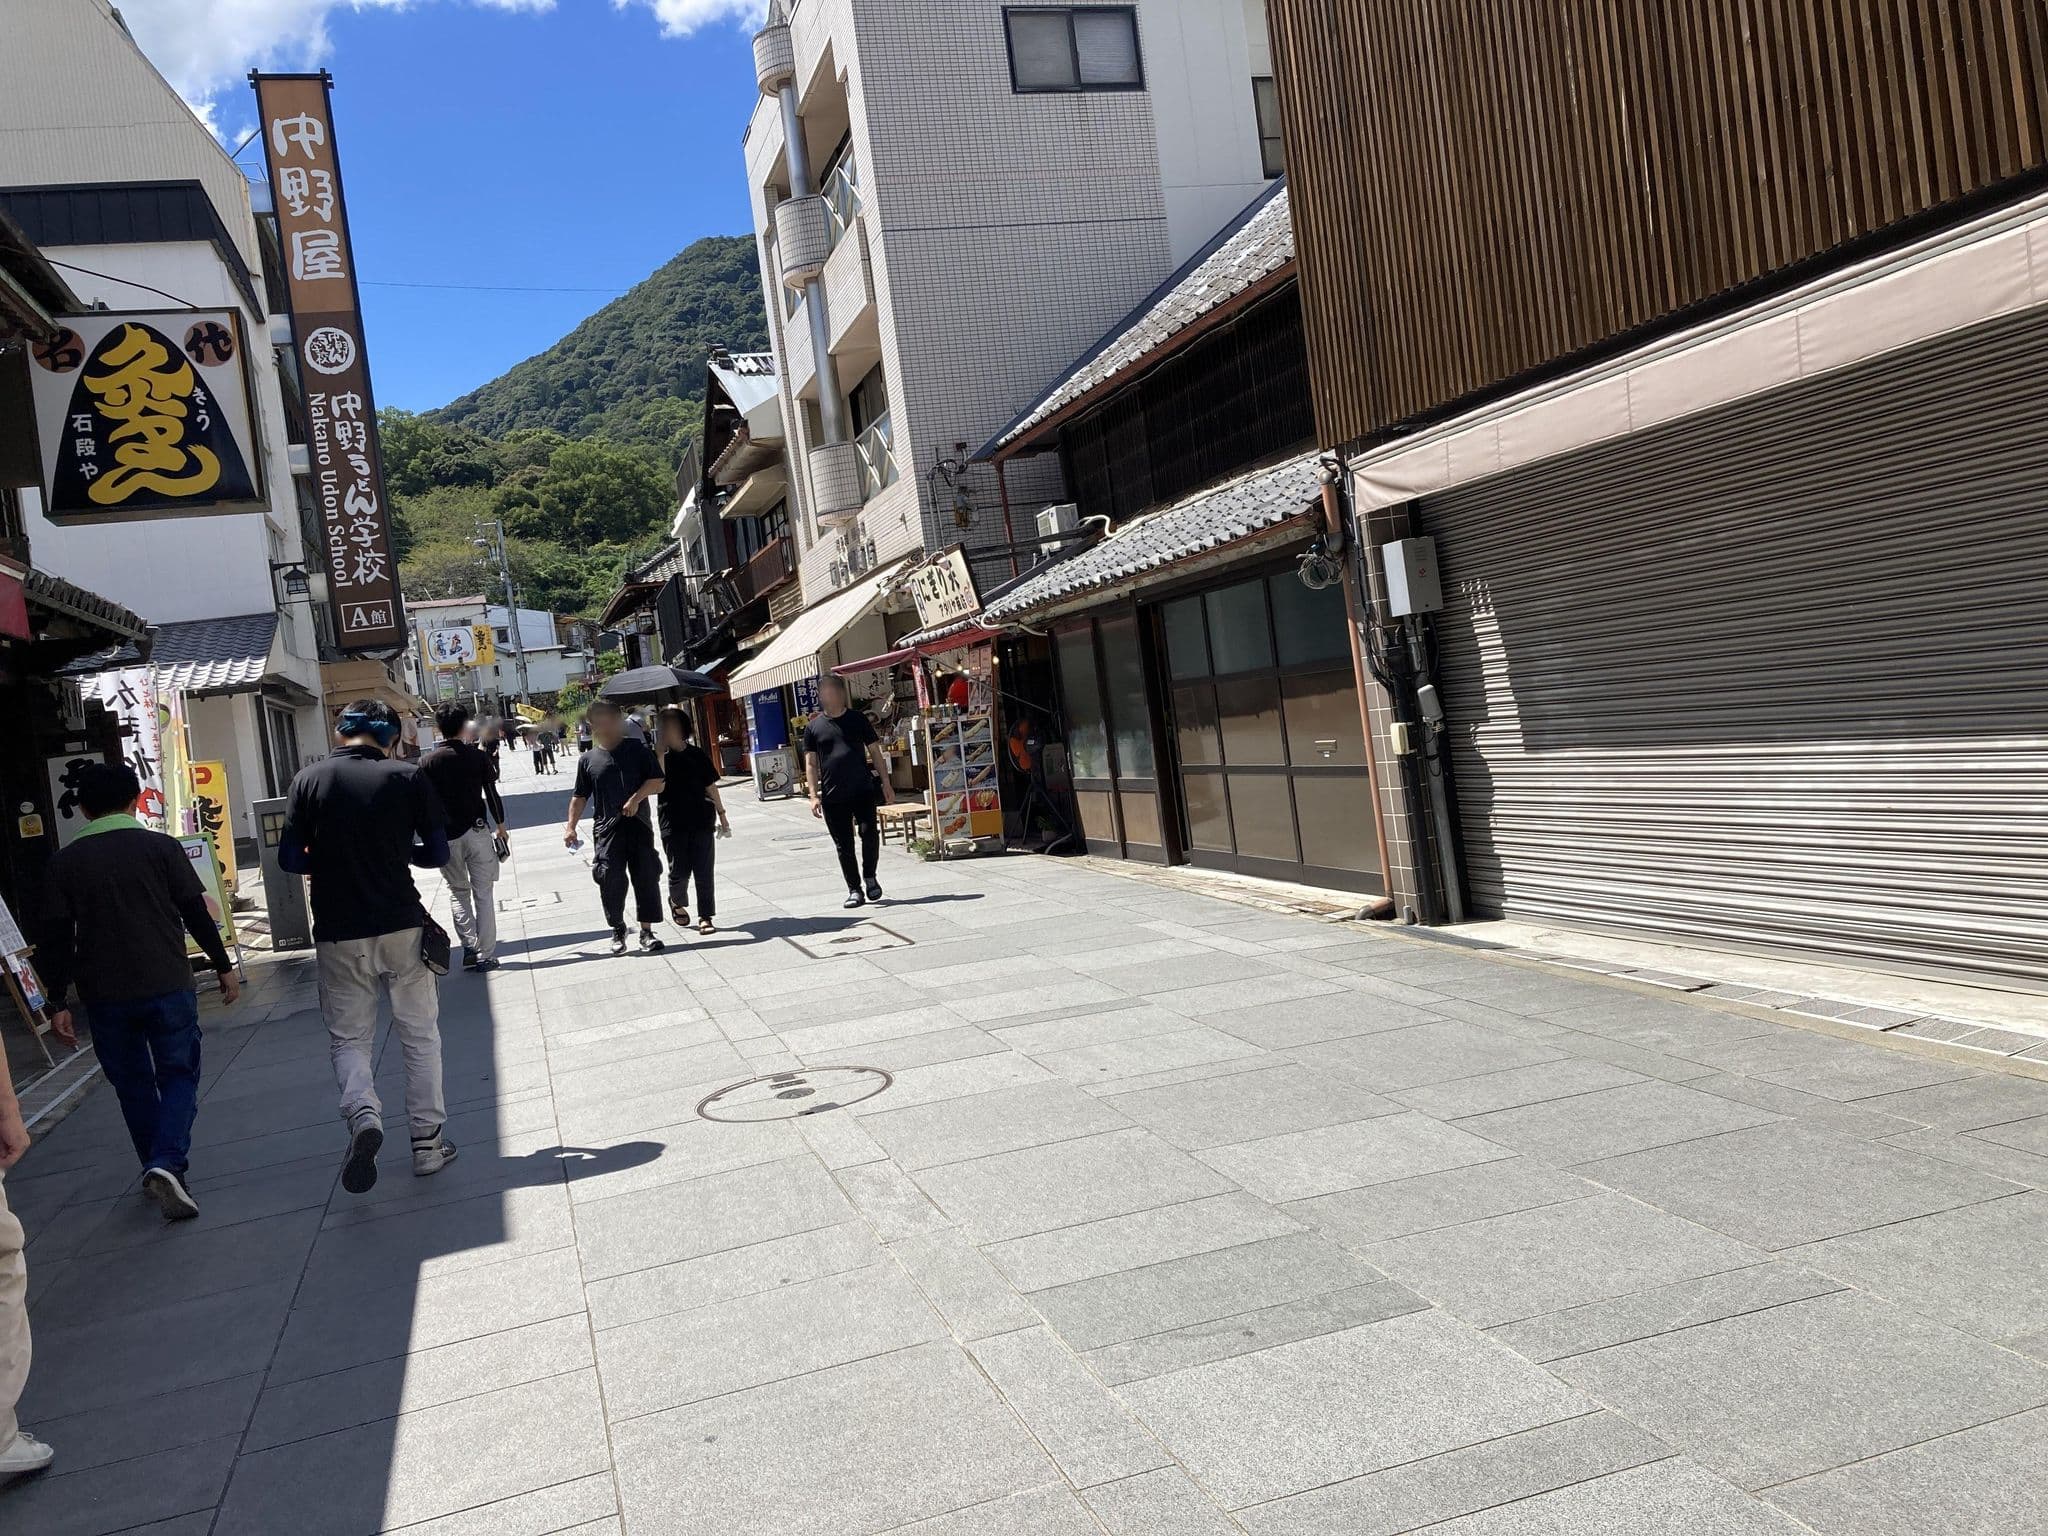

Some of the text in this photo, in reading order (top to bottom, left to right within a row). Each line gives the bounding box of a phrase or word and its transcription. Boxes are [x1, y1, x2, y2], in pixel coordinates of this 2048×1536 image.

[272, 111, 345, 280] 中野屋
[184, 322, 233, 364] 代
[72, 413, 99, 480] 石段や
[309, 392, 353, 588] Nakano Udon School
[331, 390, 390, 586] 中野うどん学校
